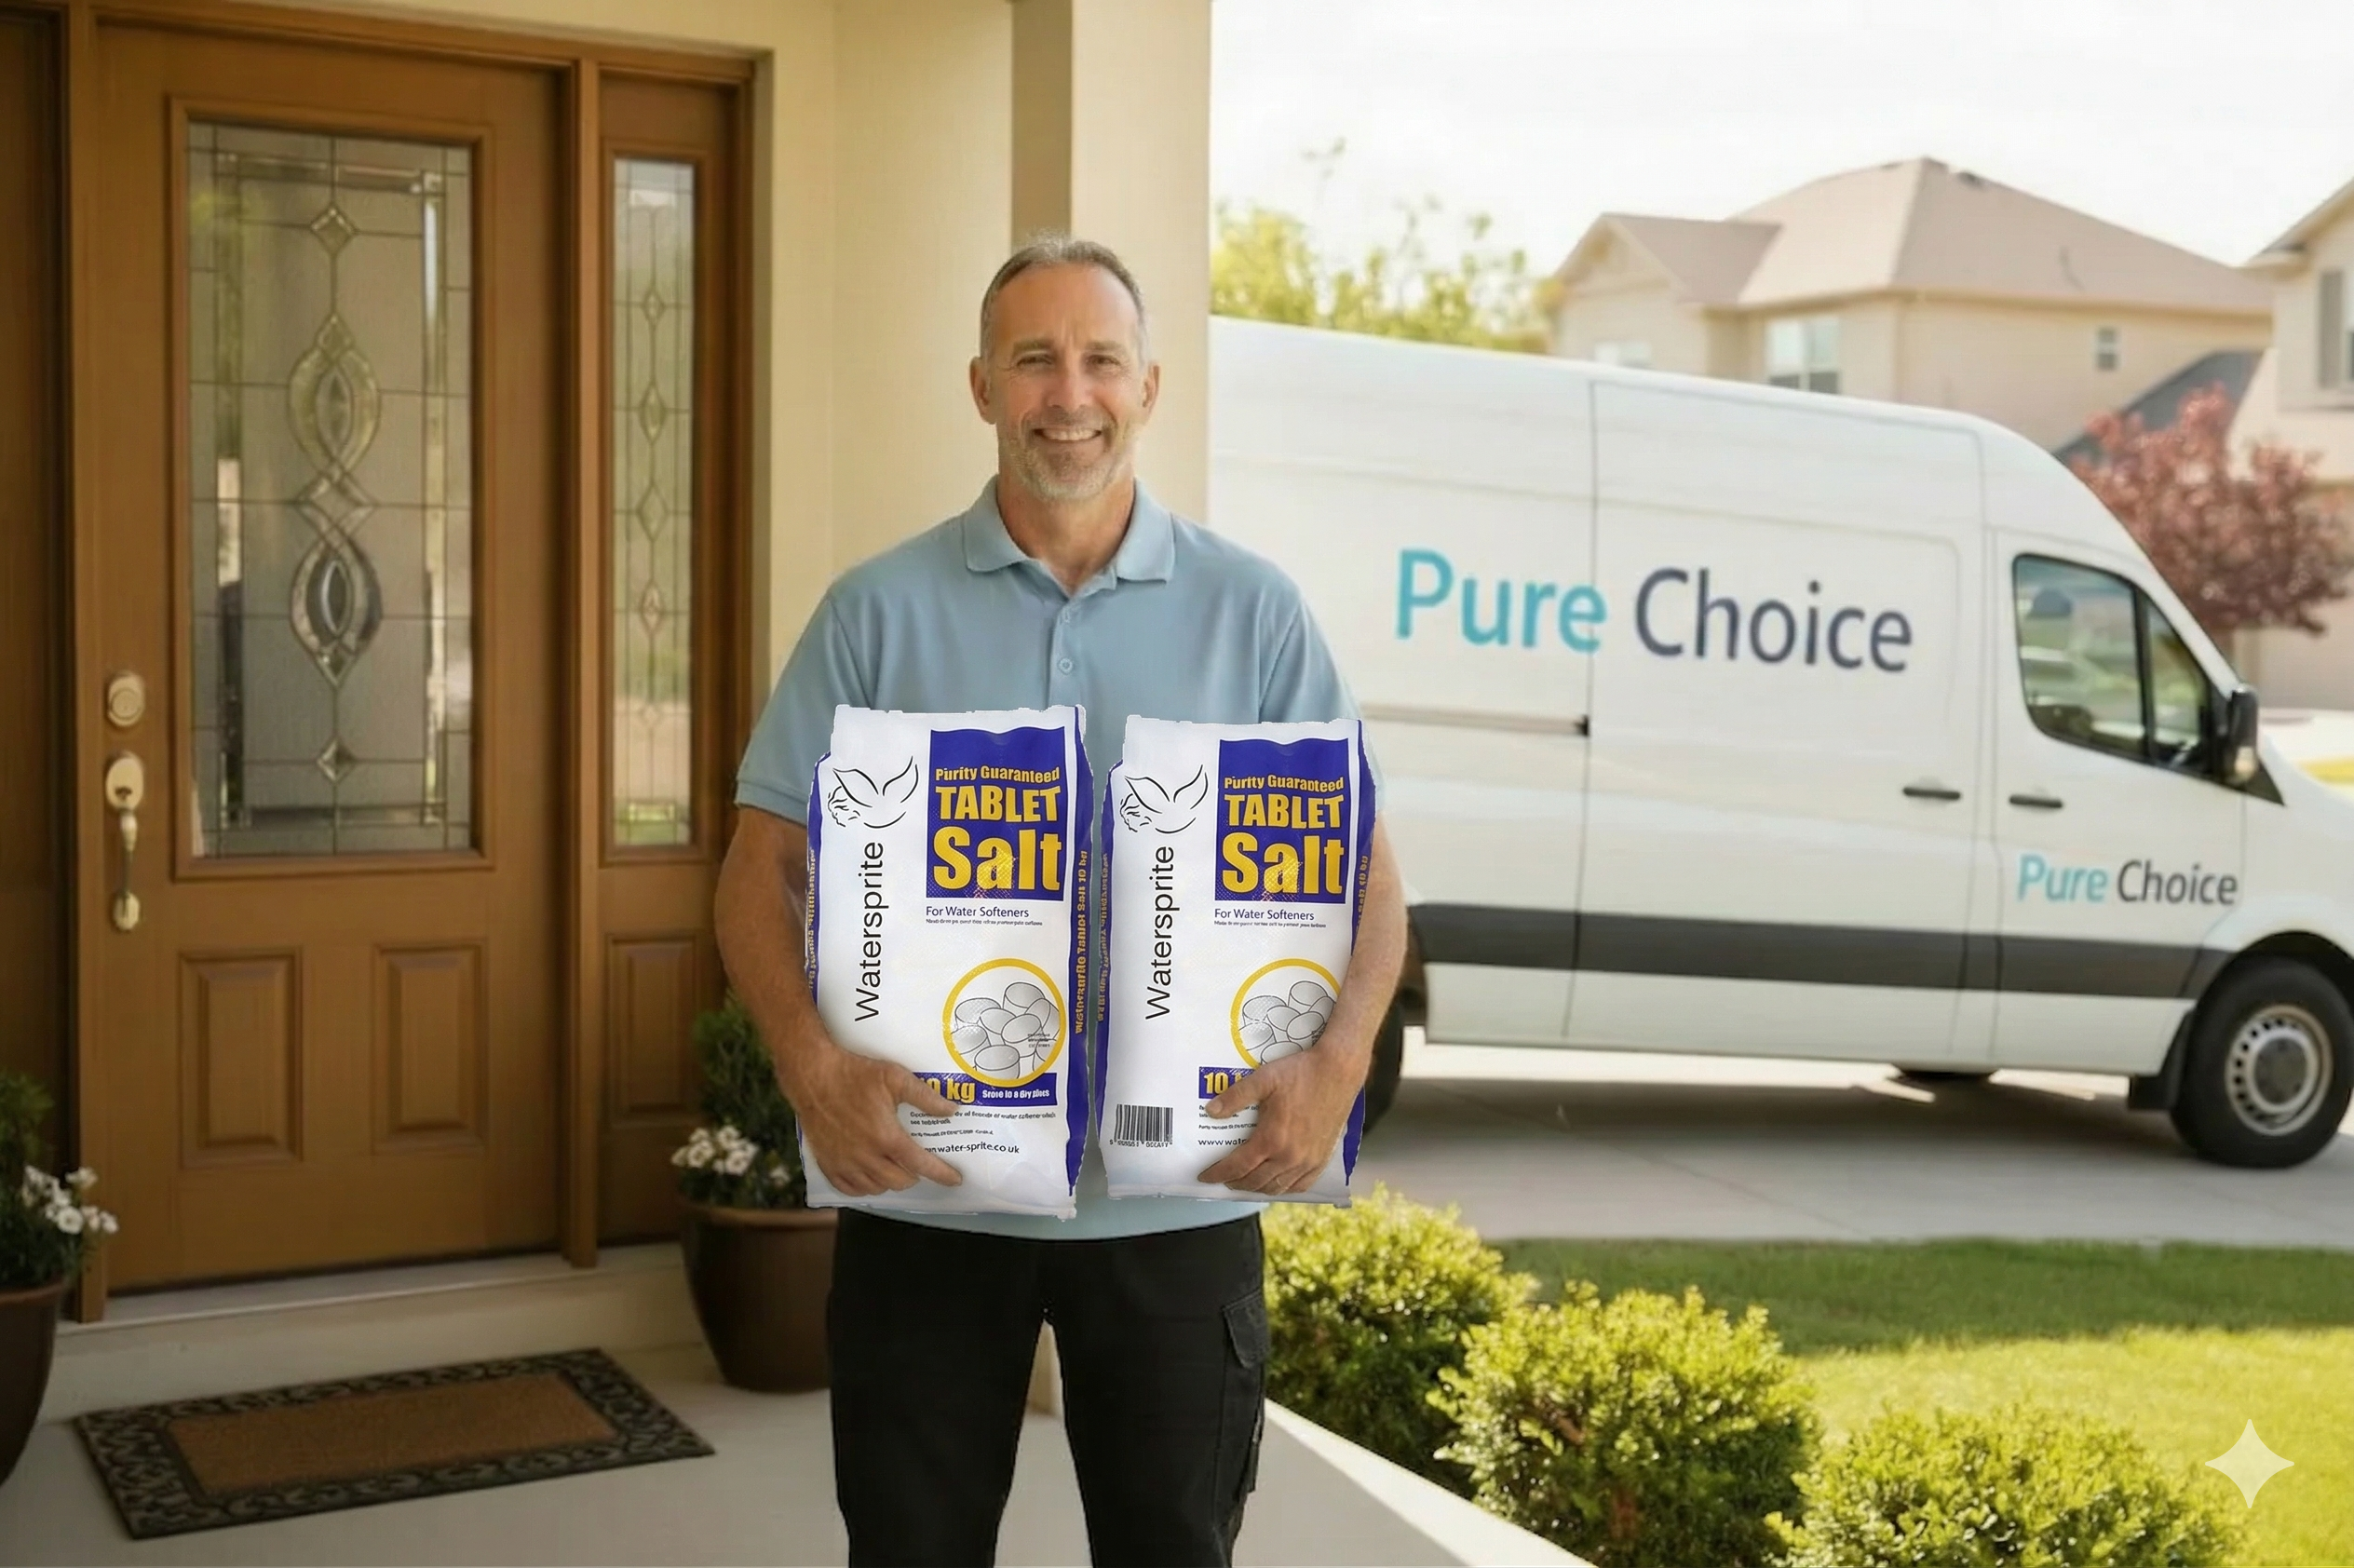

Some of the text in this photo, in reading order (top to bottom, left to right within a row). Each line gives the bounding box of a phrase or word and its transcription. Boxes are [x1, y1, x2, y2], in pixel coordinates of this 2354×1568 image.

[1394, 548, 1914, 672] Pure Choice
[935, 765, 1060, 783] Purity Guaranteed
[1224, 774, 1344, 792] Purity Guaranteed
[935, 785, 1061, 822] TABLET
[1224, 793, 1344, 829] TABLET
[933, 826, 1062, 891] Salt
[1222, 831, 1345, 895] Salt
[2017, 854, 2239, 905] Pure Choice
[926, 906, 1029, 917] For Water Softeners
[1214, 908, 1315, 920] For Water Softeners
[855, 842, 889, 1021] Watersprite
[1145, 846, 1180, 1020] Watersprite
[947, 1077, 975, 1103] kg
[1204, 1072, 1229, 1095] 10
